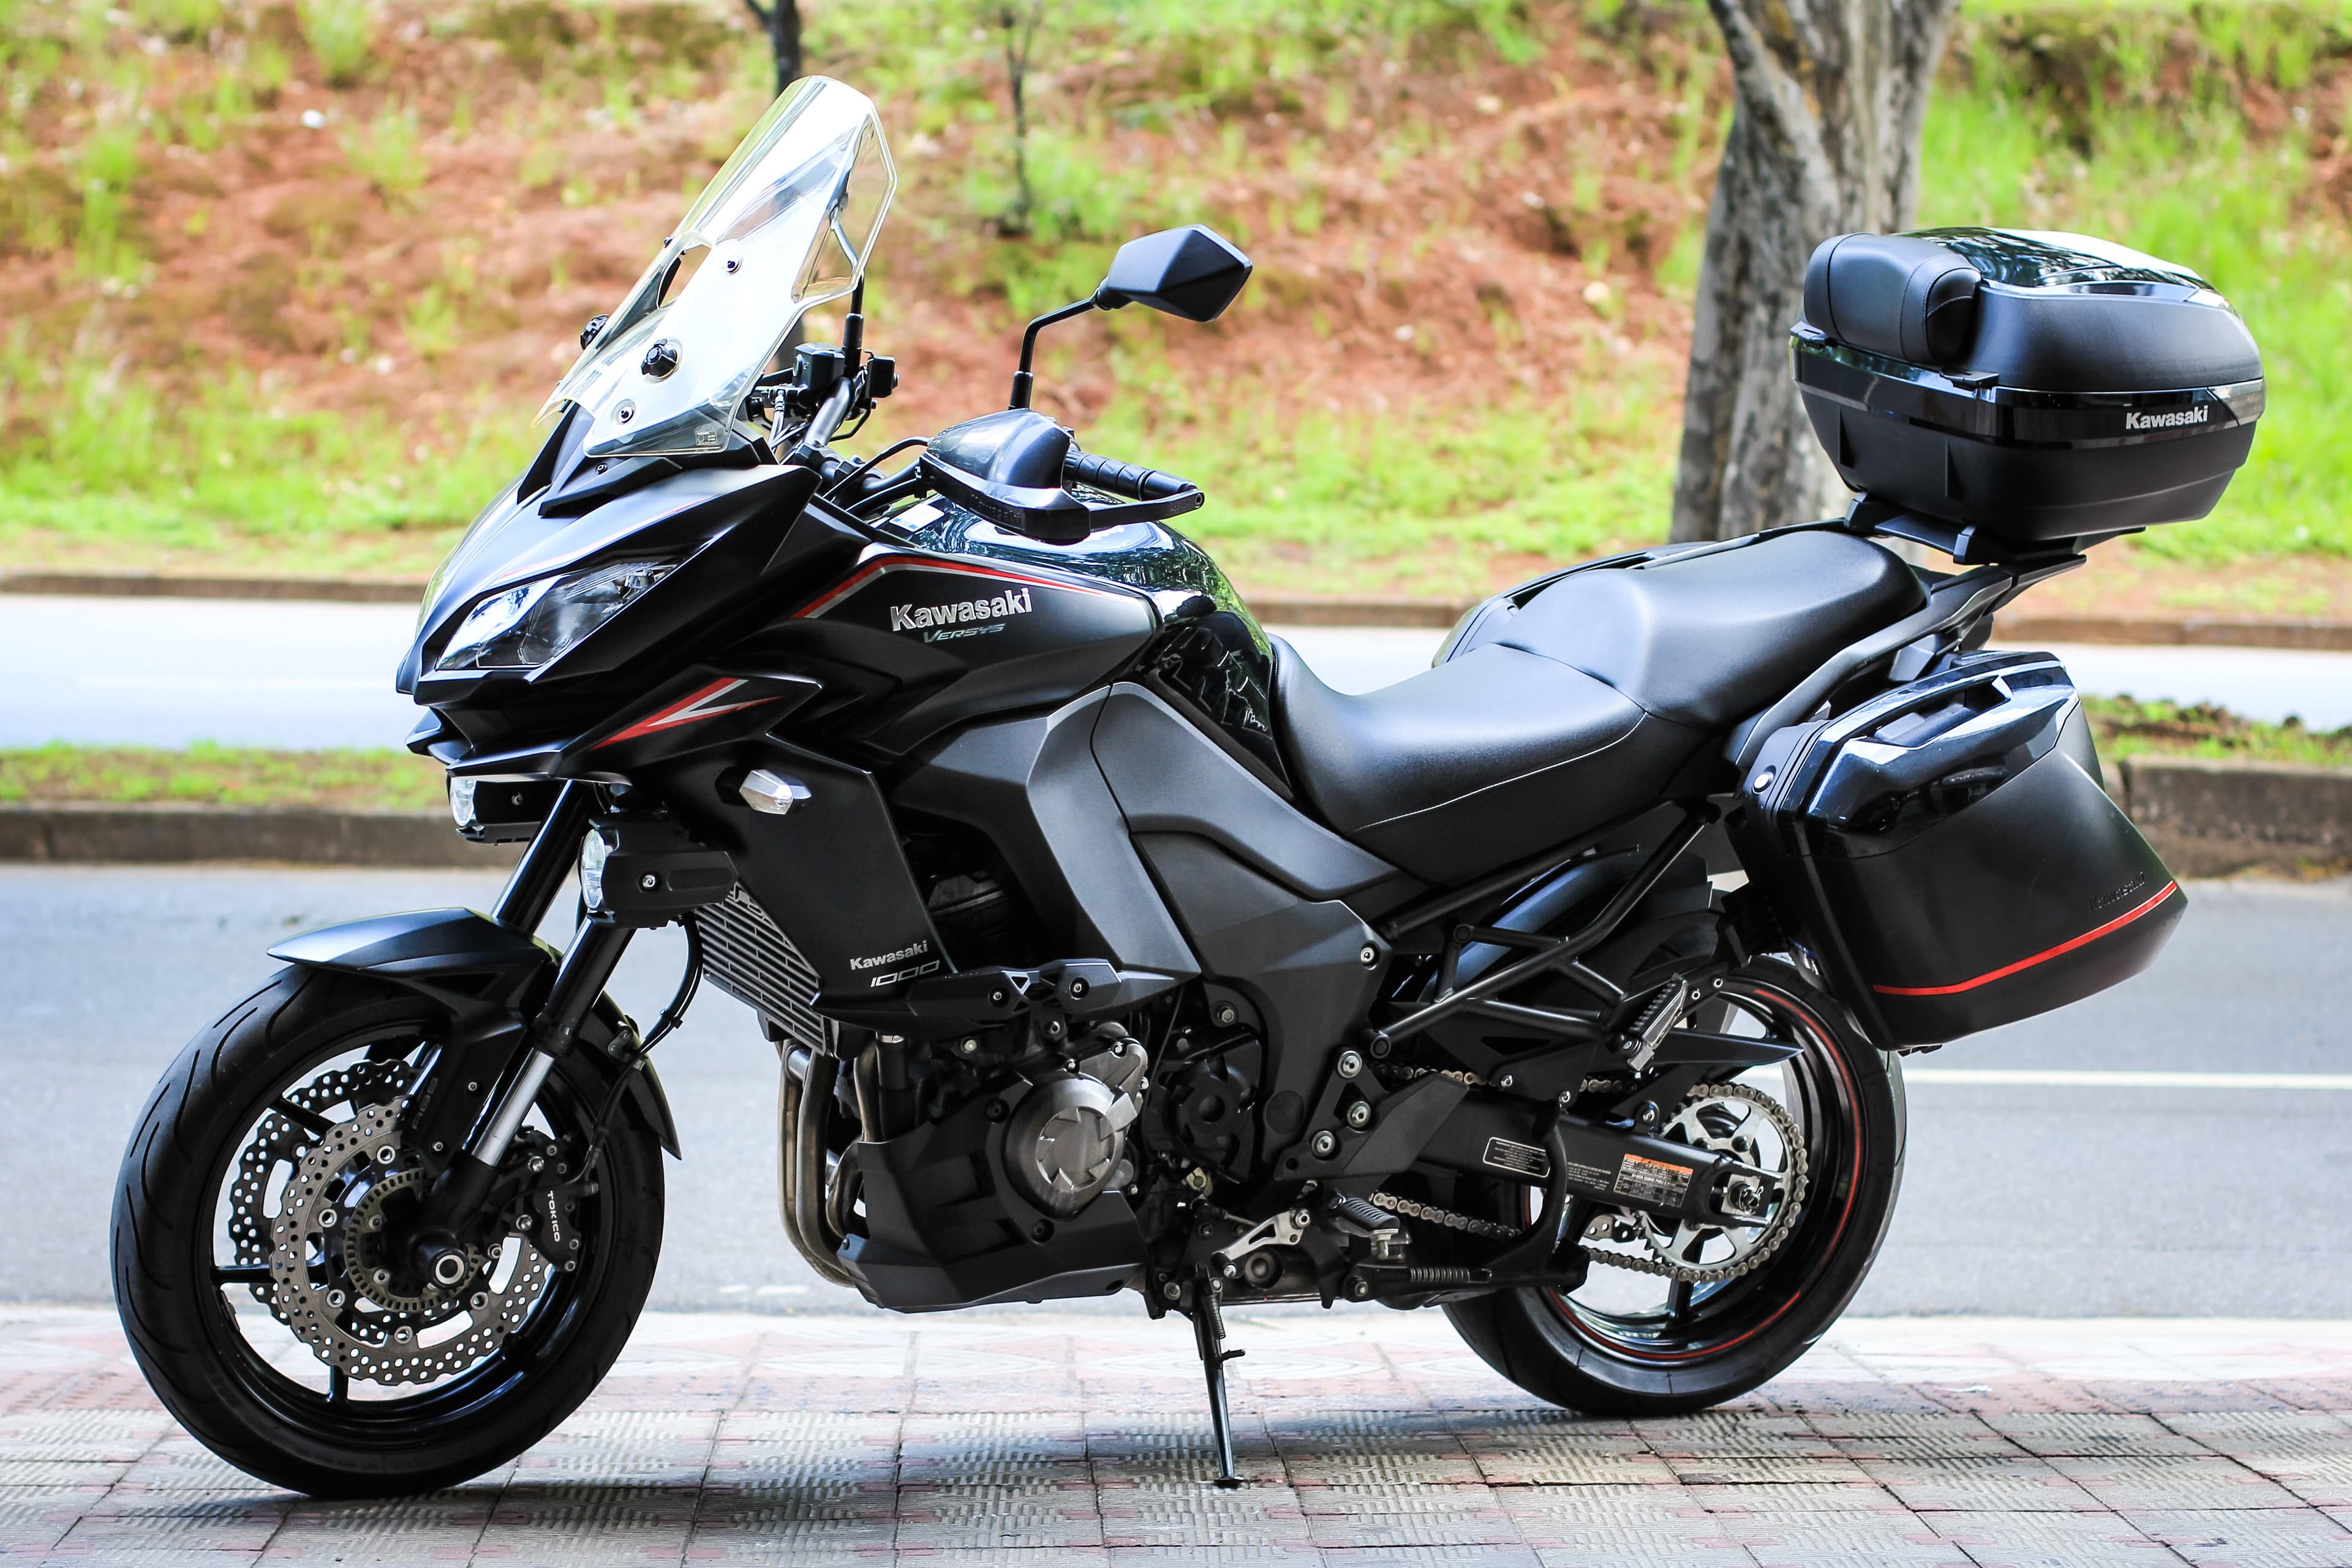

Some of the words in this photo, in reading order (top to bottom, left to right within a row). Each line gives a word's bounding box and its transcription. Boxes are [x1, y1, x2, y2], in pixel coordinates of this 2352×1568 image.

[2125, 404, 2209, 429] Kawasaki
[890, 587, 1033, 631] Kawasaki
[2089, 871, 2145, 914] Kawasaki
[850, 940, 929, 970] Kawasaki
[870, 960, 940, 987] 1000
[412, 1077, 439, 1130] ABS
[547, 1190, 560, 1243] TOKICO
